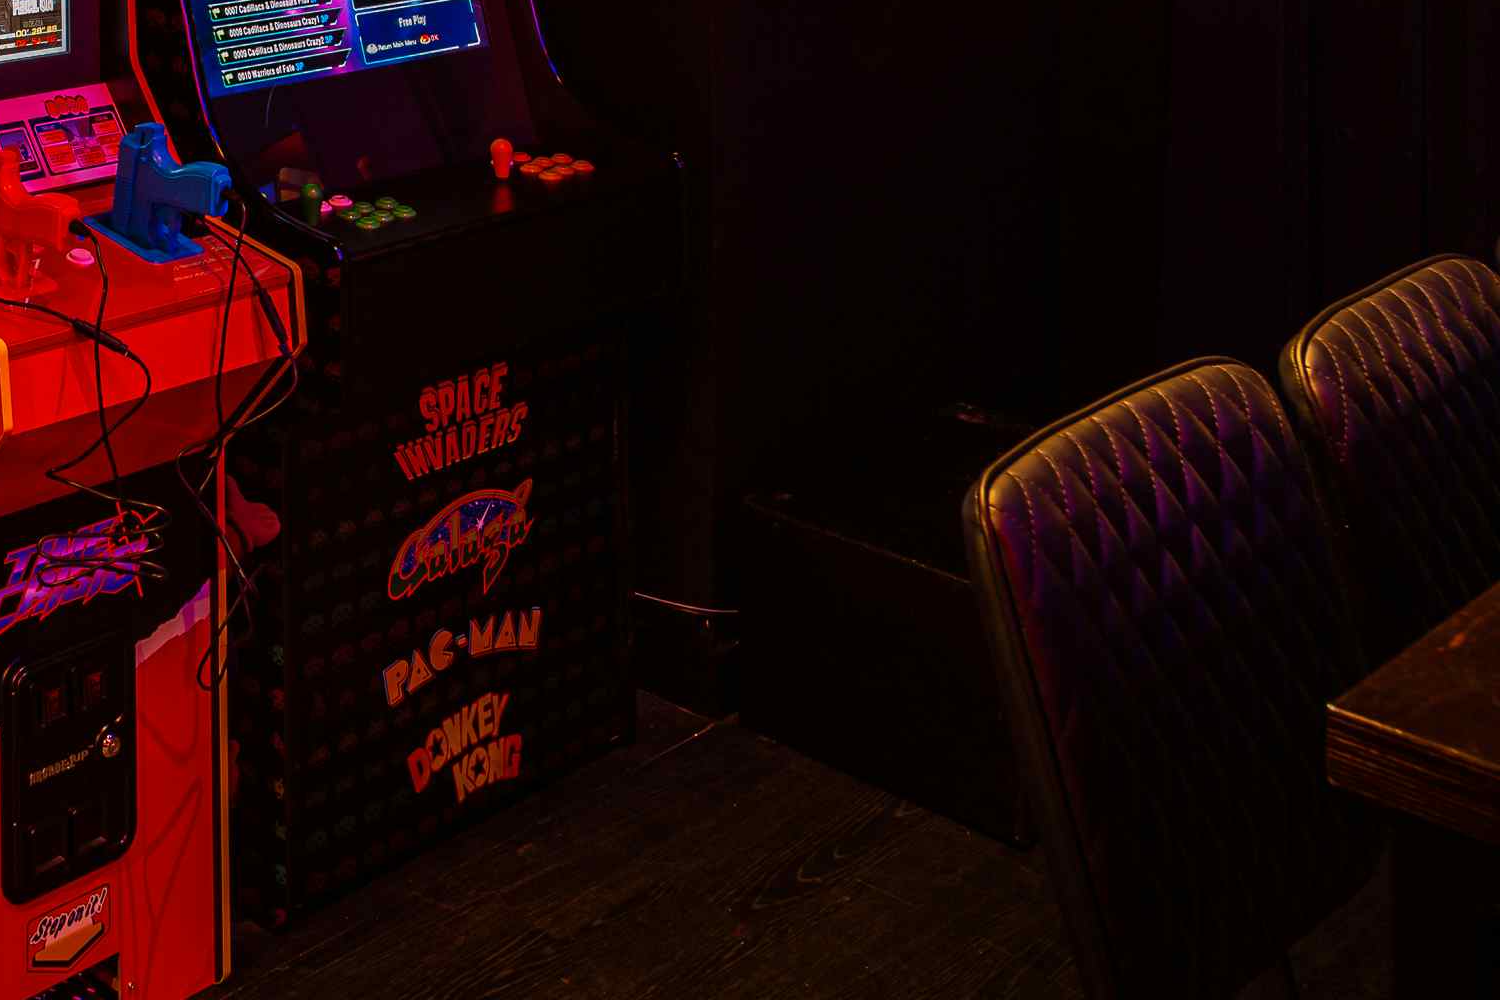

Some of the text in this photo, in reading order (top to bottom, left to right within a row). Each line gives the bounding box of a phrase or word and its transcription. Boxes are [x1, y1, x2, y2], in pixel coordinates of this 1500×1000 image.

[398, 15, 427, 28] Free Play
[419, 361, 509, 433] SPACE
[392, 401, 530, 481] INVADERS
[382, 606, 541, 705] PAC-MAN
[407, 691, 509, 793] DONKEY
[453, 733, 523, 803] KONG
